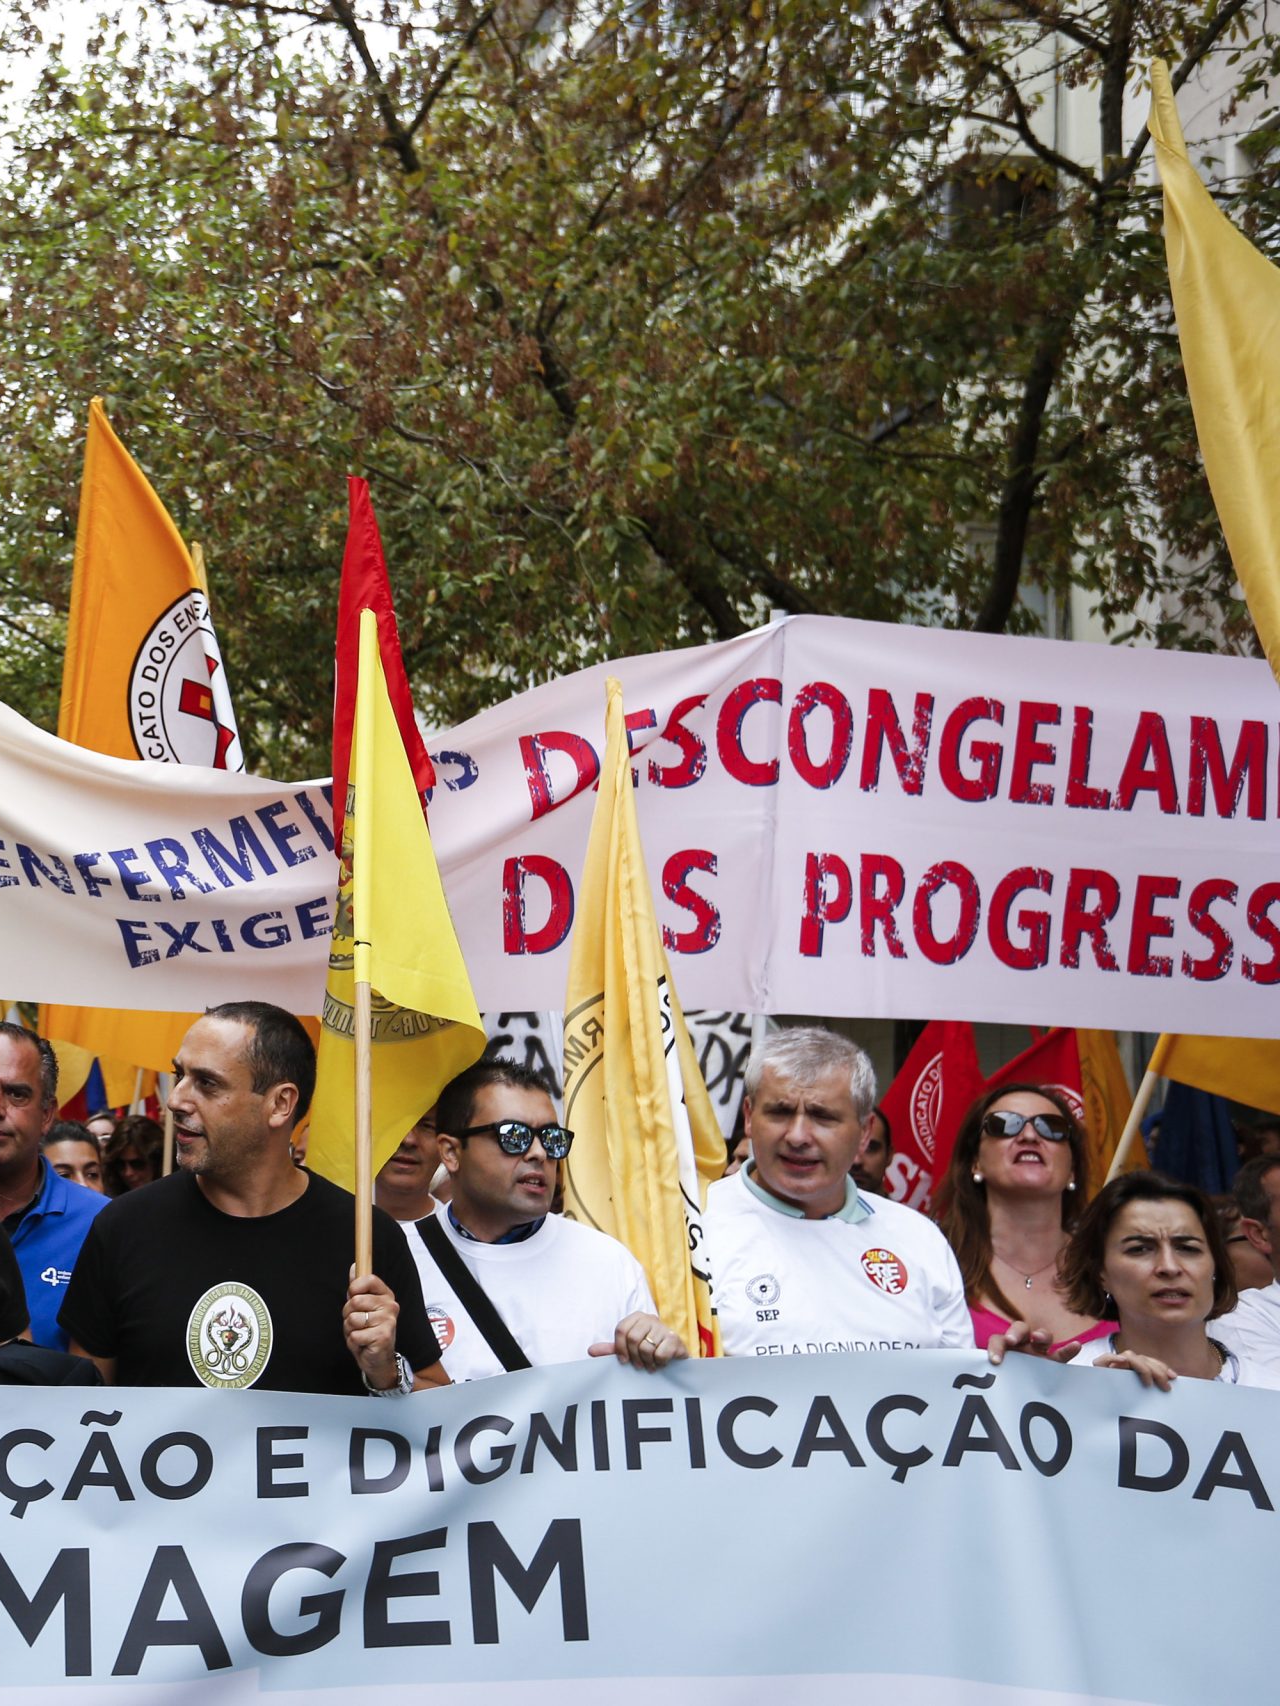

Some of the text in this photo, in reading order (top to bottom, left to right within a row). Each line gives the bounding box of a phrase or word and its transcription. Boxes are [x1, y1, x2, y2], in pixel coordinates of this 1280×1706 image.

[141, 629, 175, 684] DOS
[502, 848, 722, 956] DS
[755, 1308, 780, 1322] SEP
[256, 1425, 311, 1500] E
[349, 1371, 1074, 1495] DIGNIFICAÇÃO
[1117, 1414, 1276, 1512] DA
